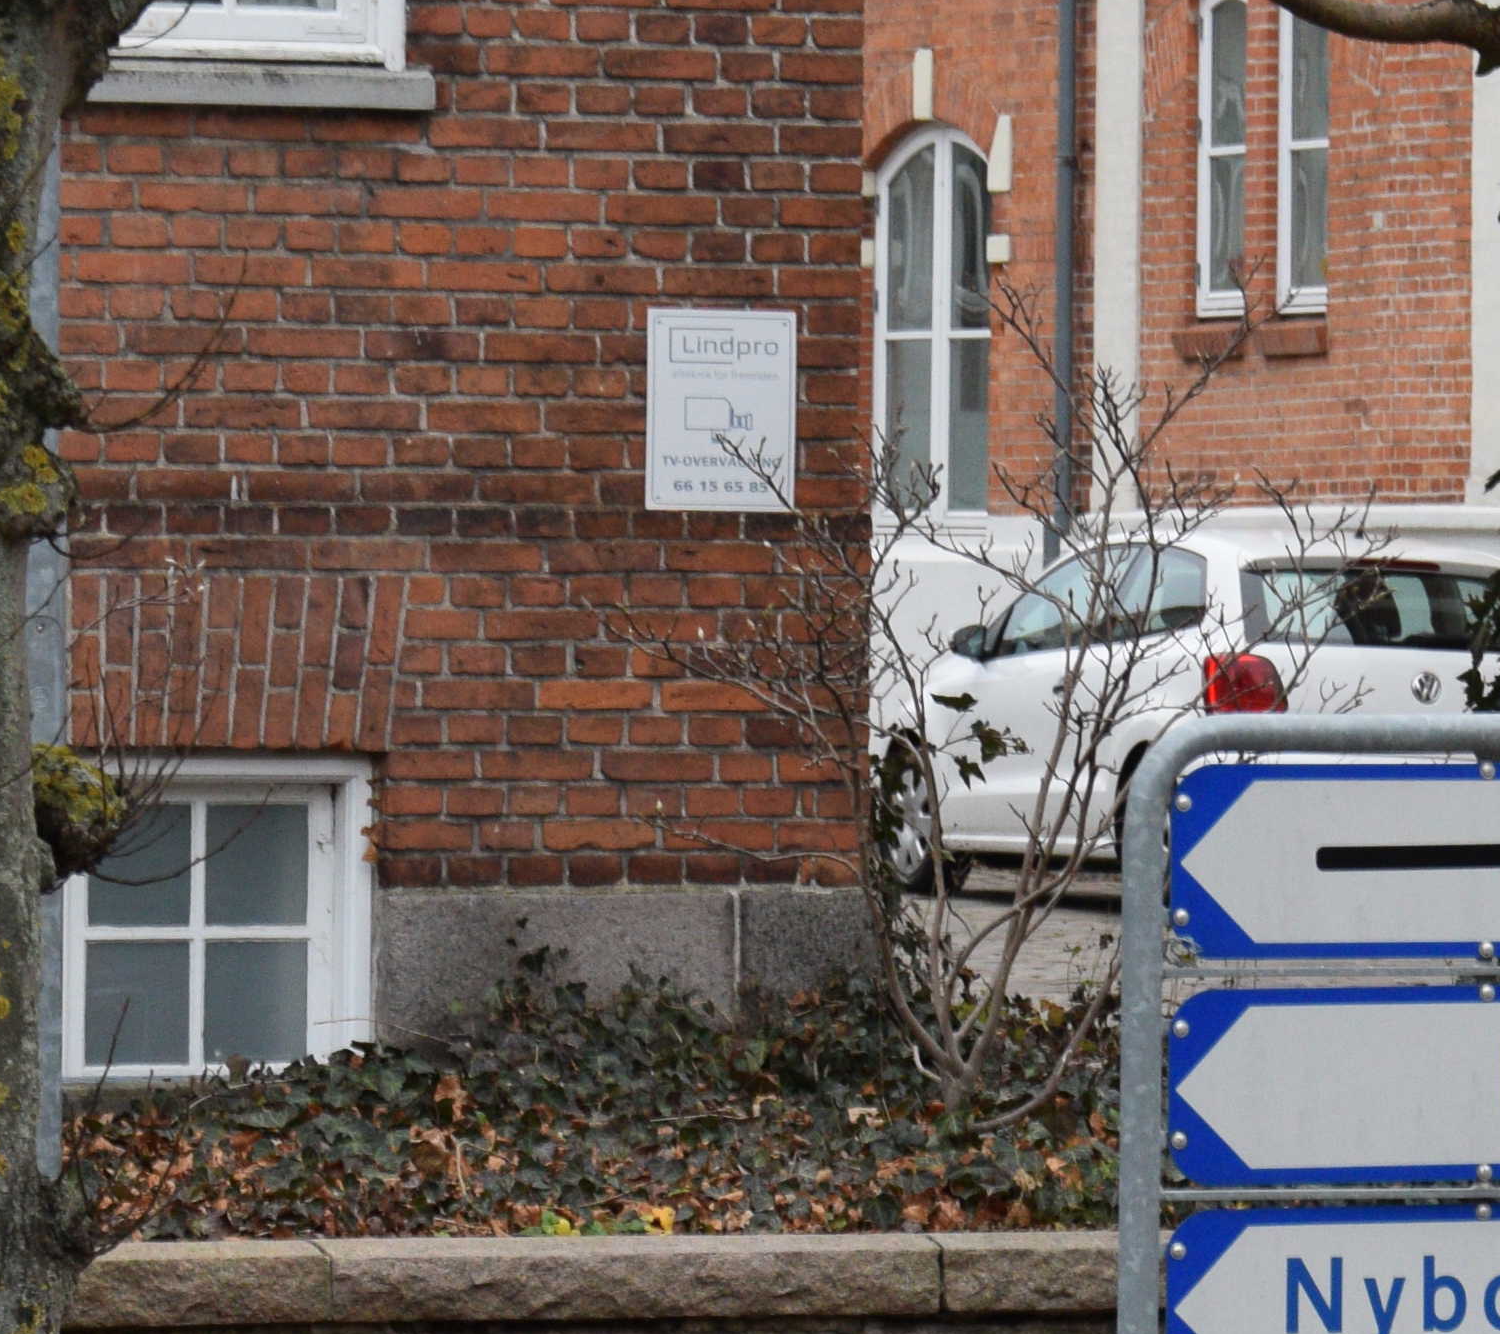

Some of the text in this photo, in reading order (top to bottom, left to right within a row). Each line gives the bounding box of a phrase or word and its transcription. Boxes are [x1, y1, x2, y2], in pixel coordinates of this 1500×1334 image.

[682, 335, 780, 361] Lindpro
[672, 480, 694, 493] 66
[699, 480, 719, 493] 15
[723, 481, 744, 494] 65
